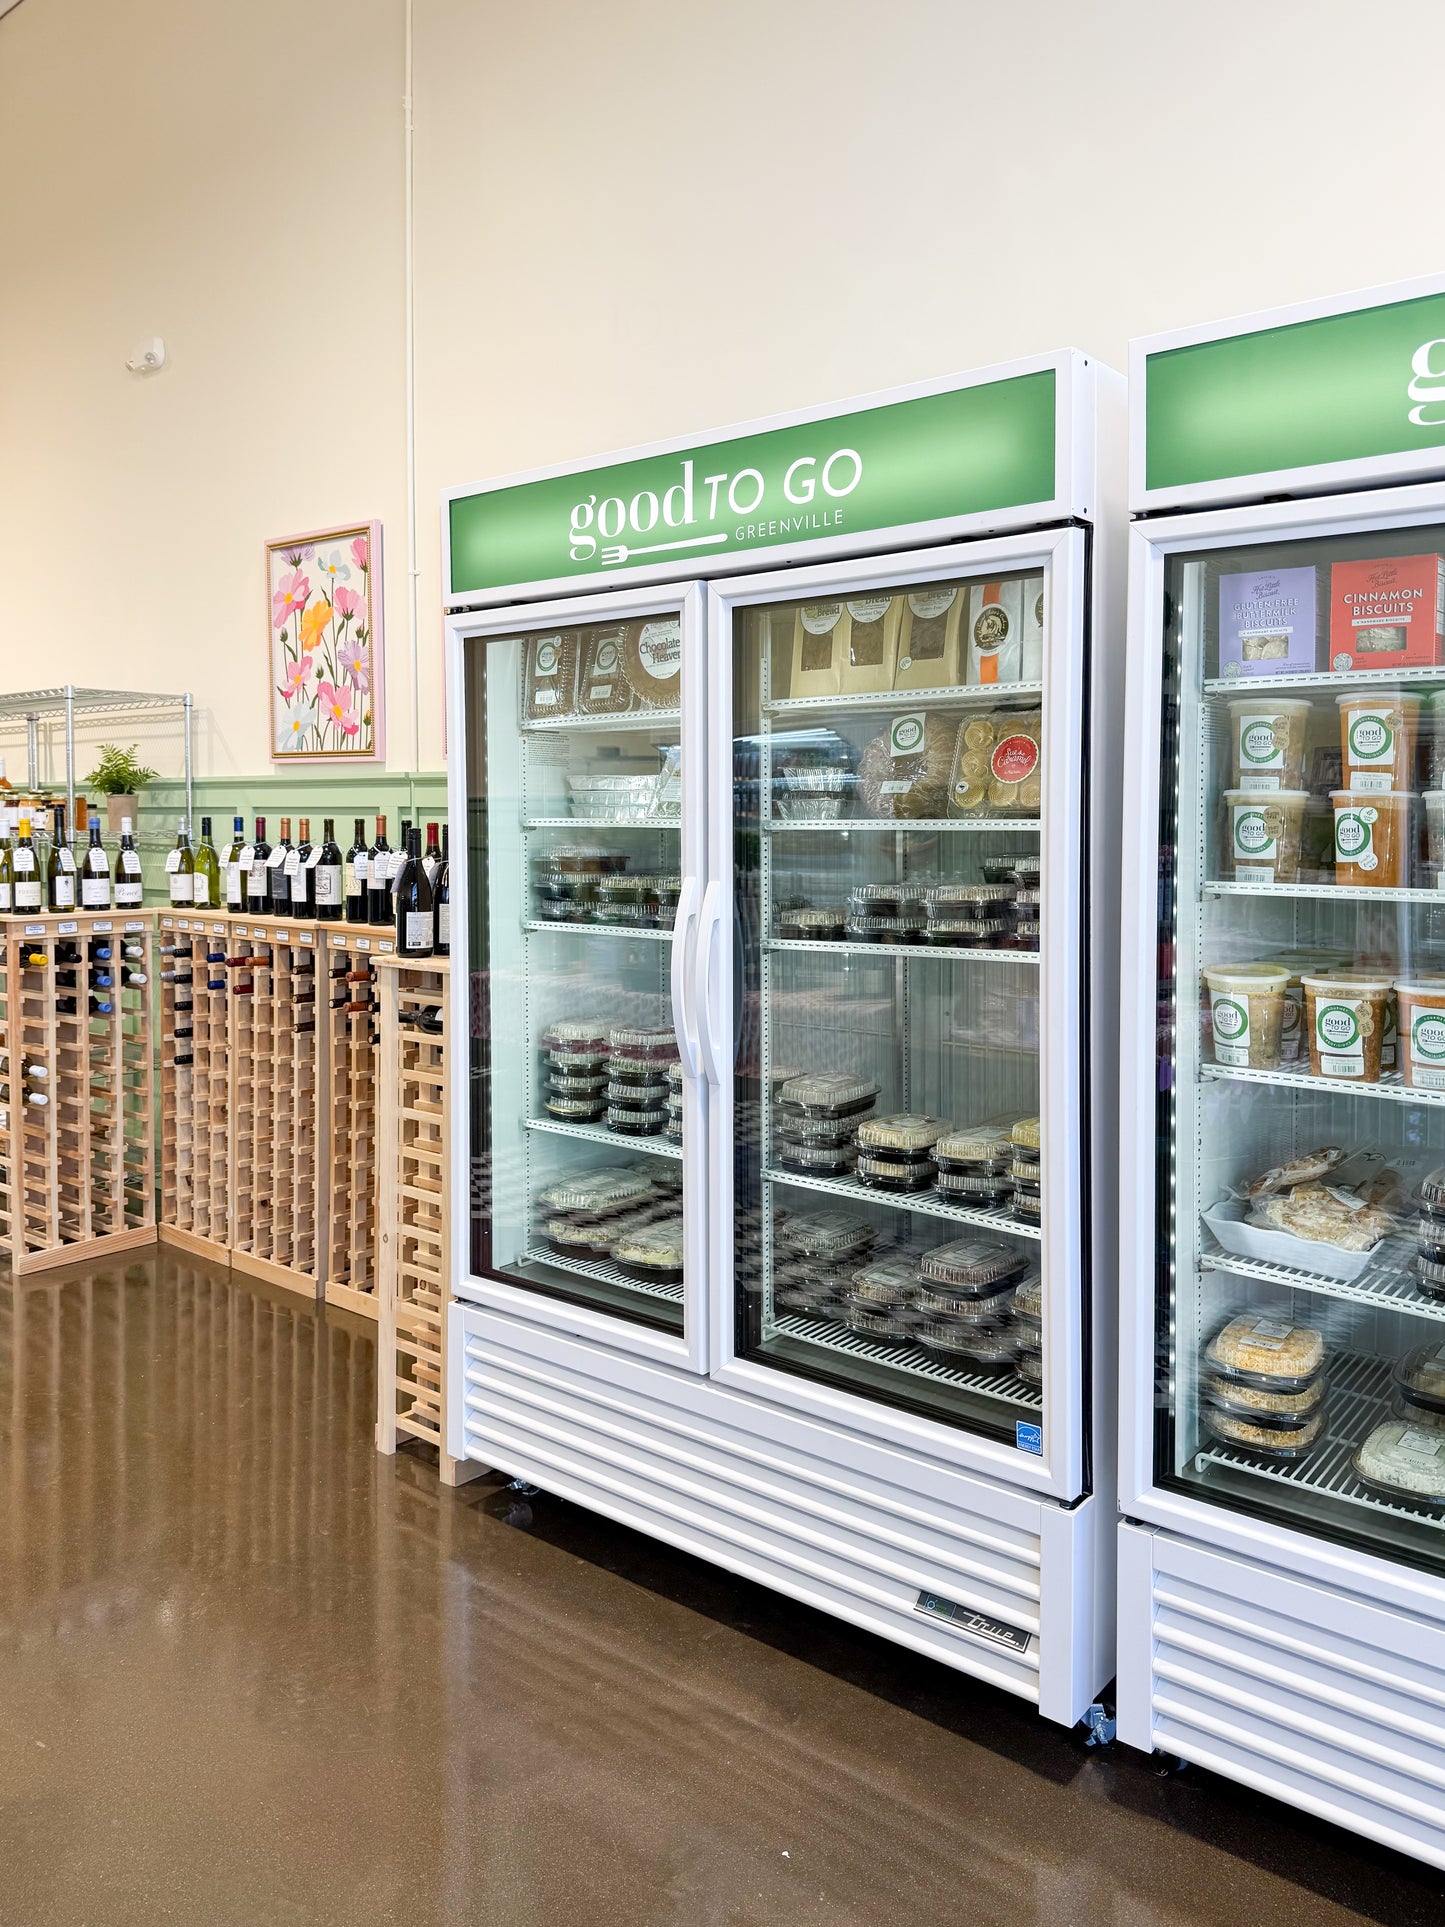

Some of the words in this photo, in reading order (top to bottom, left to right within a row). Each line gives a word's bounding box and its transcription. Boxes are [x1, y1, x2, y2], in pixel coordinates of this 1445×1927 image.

[568, 459, 697, 561] good
[703, 468, 765, 521] TO
[783, 448, 863, 505] GO
[735, 509, 844, 542] GREENVILLE
[1343, 588, 1423, 604] CINNAMON
[817, 604, 840, 617] Bread
[1235, 607, 1297, 620] BUTTERMILK
[1353, 602, 1414, 616] BISCUITS
[1244, 617, 1288, 629] BISCUITS
[640, 637, 681, 655] Chocolate
[1248, 732, 1273, 744] good
[1325, 1017, 1351, 1027] good
